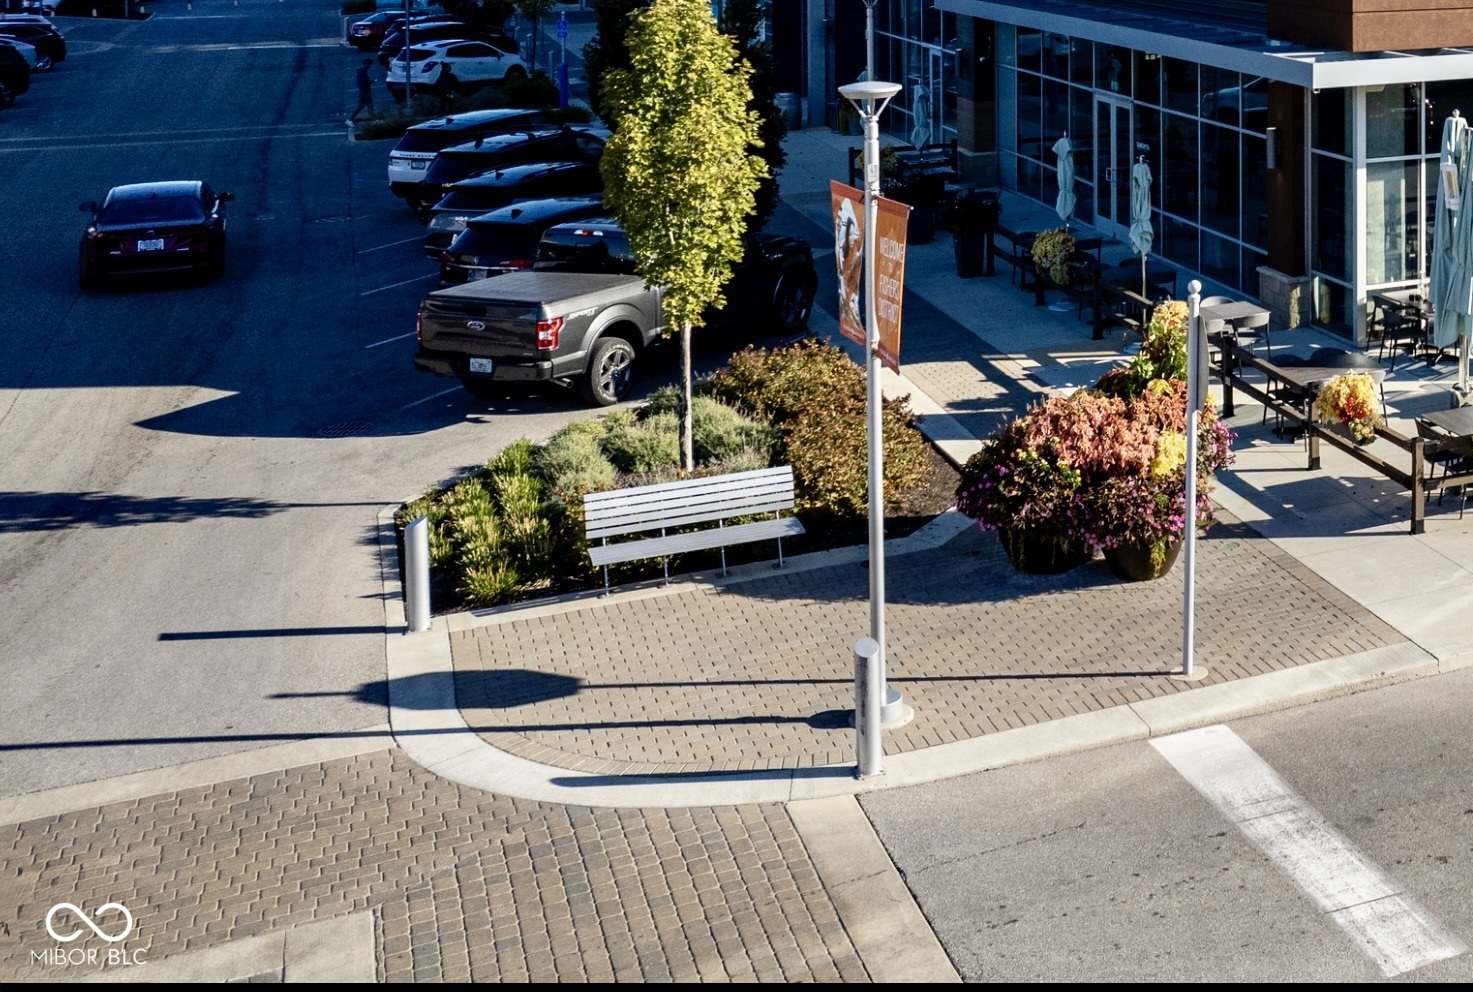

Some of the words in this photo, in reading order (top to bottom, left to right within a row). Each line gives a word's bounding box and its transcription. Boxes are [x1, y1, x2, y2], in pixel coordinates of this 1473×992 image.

[879, 236, 905, 263] WELCOME
[879, 273, 900, 301] FISHERS
[878, 297, 900, 324] DISTRICT
